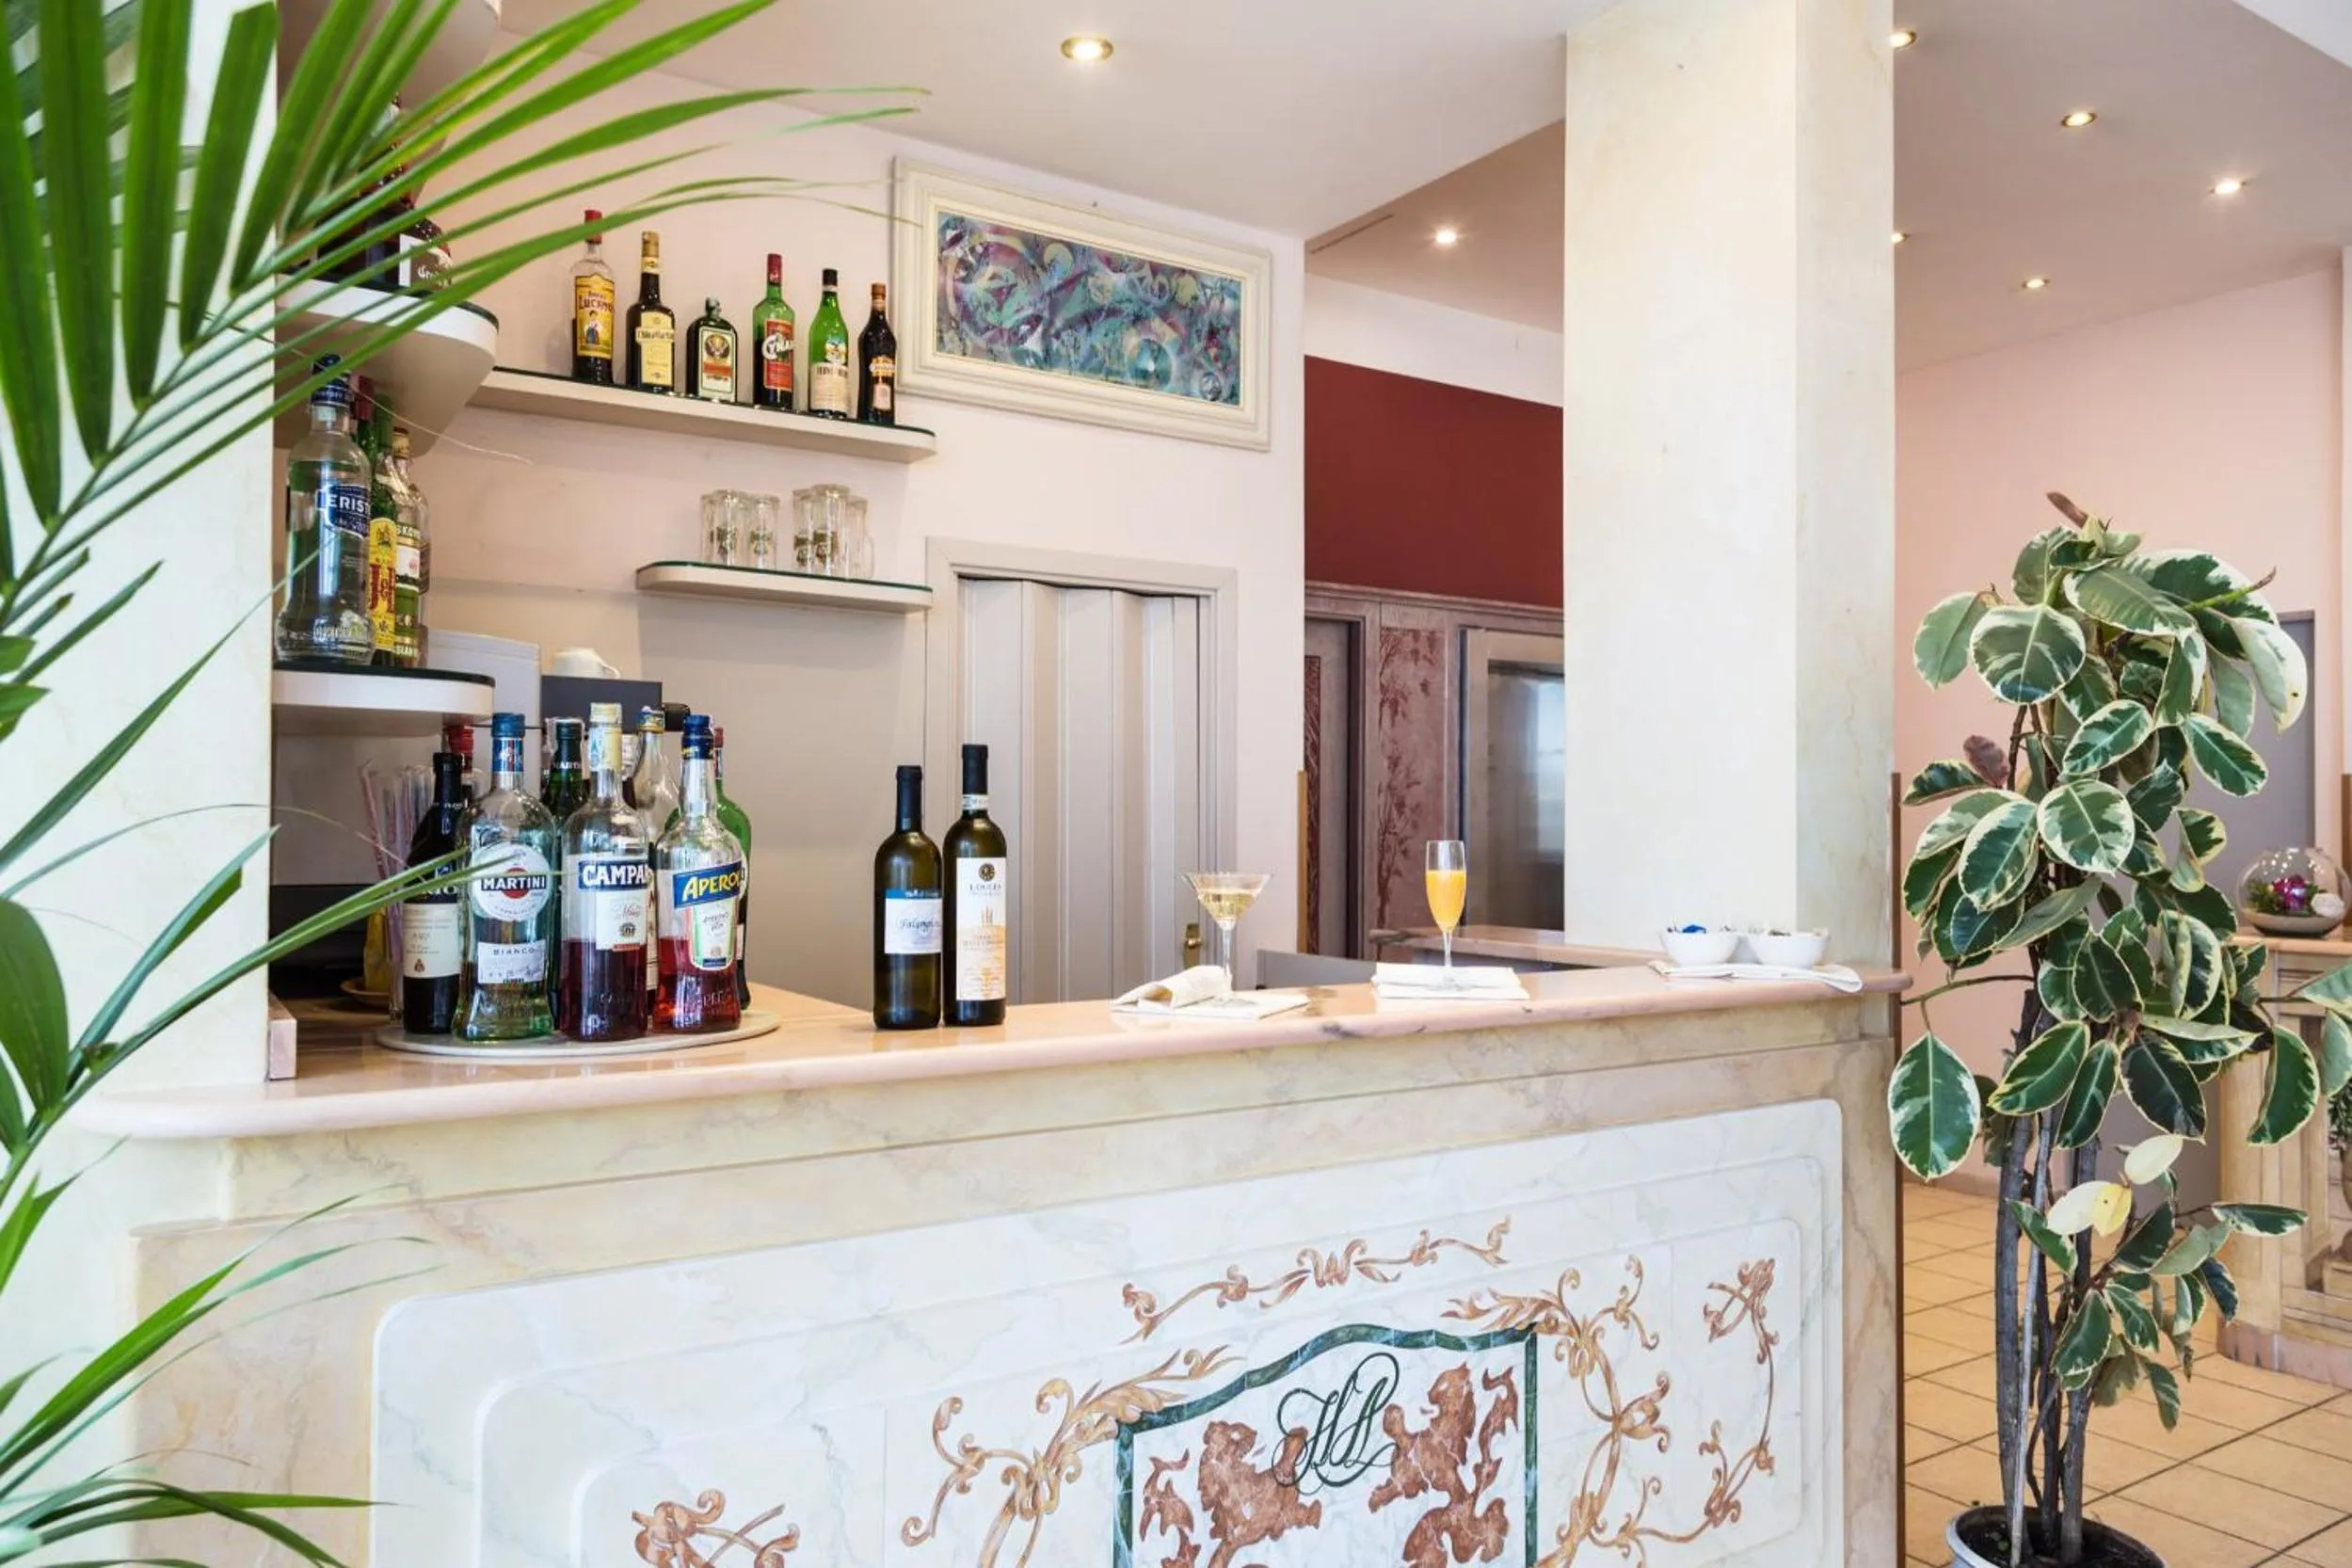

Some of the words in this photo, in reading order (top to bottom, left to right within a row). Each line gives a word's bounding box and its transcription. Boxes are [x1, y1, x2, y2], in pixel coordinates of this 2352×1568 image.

[583, 864, 648, 887] CAMPA
[482, 876, 546, 890] MARTINI
[493, 947, 536, 955] BIANCO
